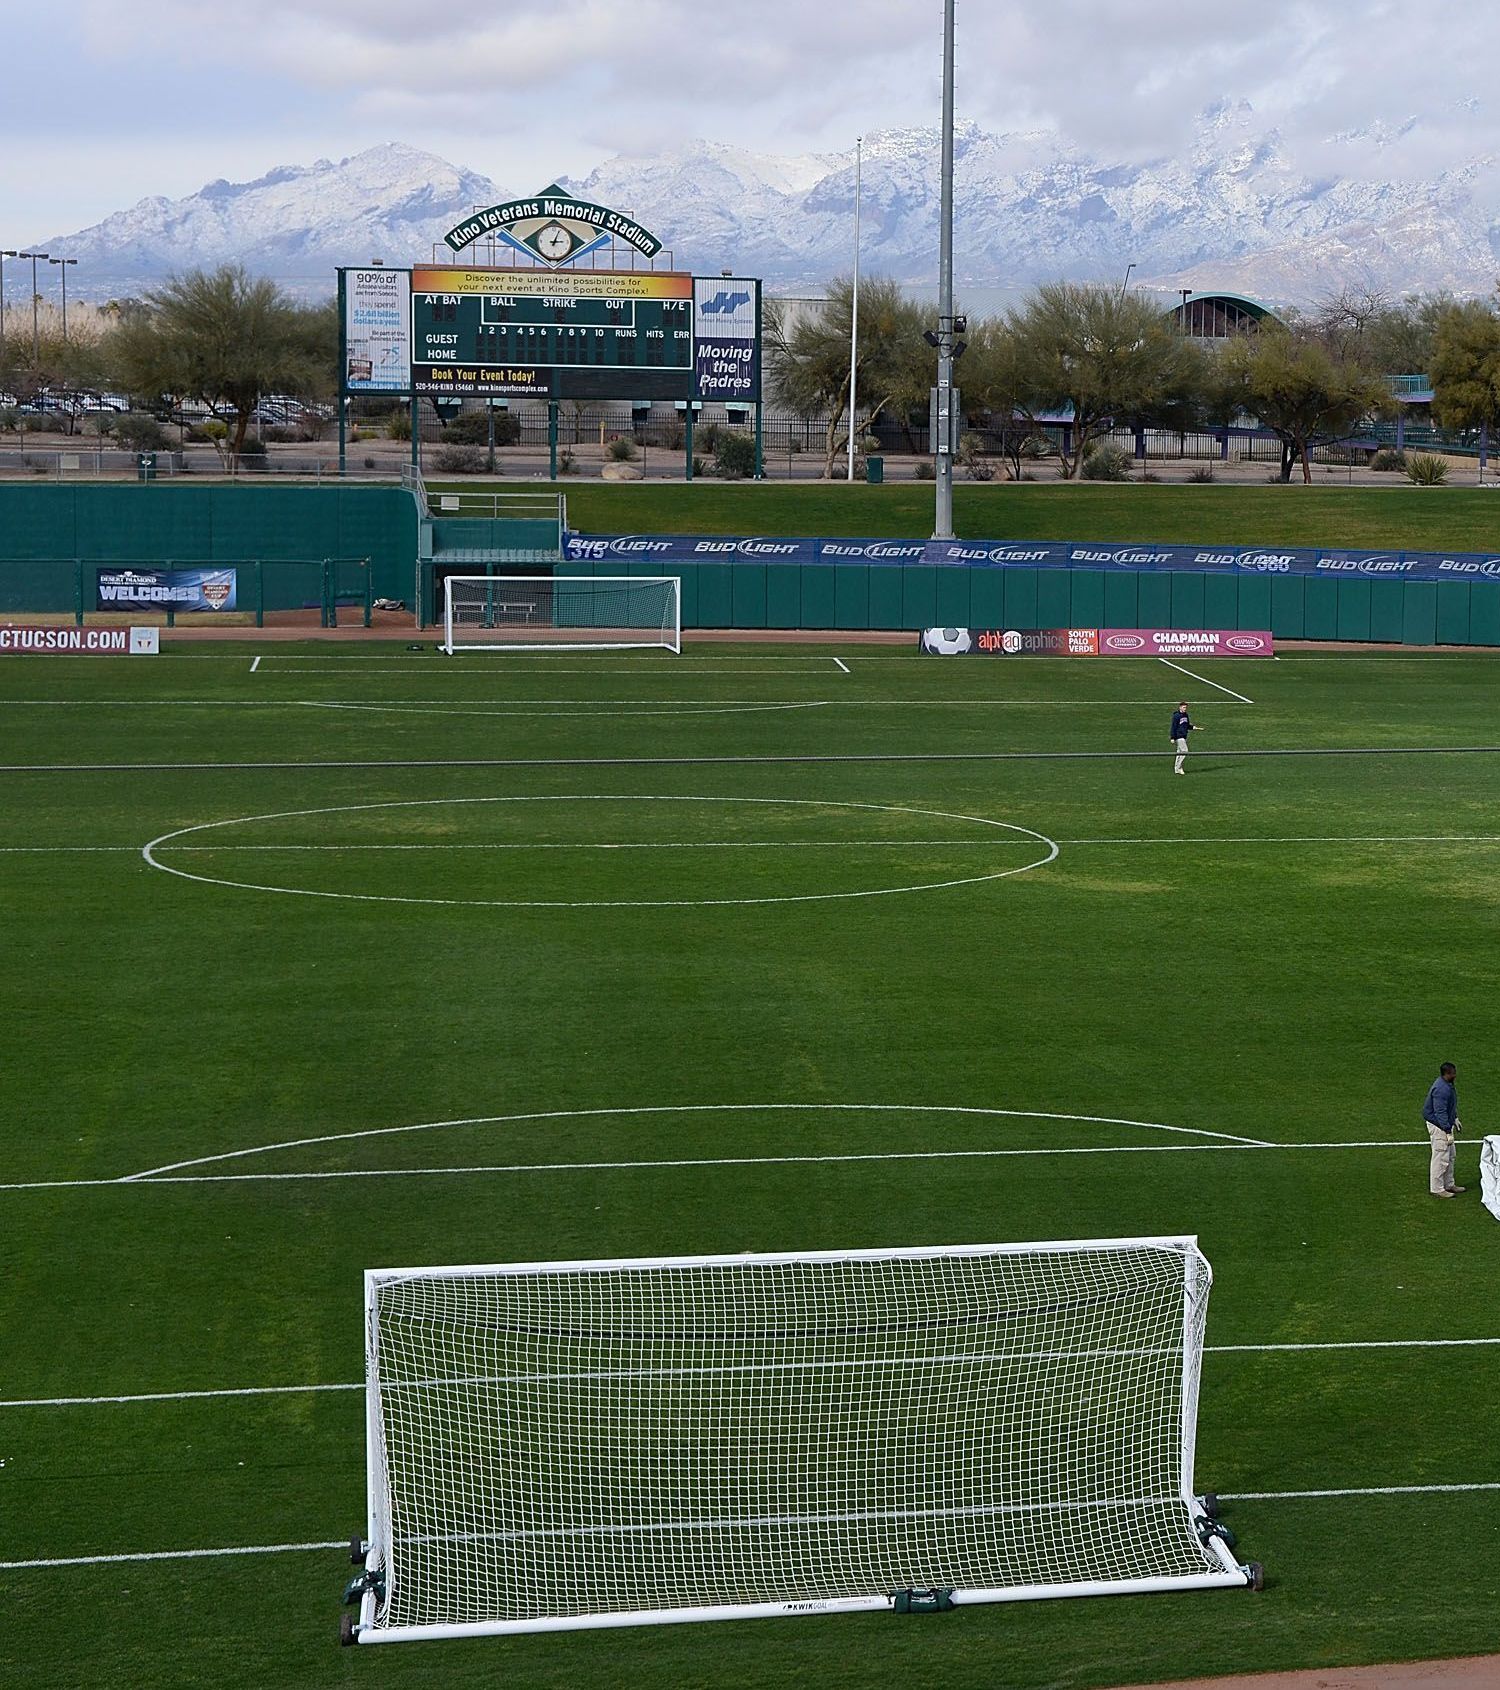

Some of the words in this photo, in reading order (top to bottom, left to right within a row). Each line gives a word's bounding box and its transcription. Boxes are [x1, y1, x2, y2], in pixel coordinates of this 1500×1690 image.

[450, 222, 480, 246] Kino
[478, 202, 538, 228] Veterans
[544, 200, 605, 224] Memorial
[606, 214, 655, 254] Stadium
[357, 274, 384, 283] 90%
[386, 274, 397, 283] of
[574, 278, 626, 286] possibilities
[425, 296, 438, 304] AT
[443, 296, 462, 305] BAT
[490, 297, 516, 306] BALL
[542, 298, 576, 308] STRIKE
[606, 300, 625, 309] OUT
[663, 302, 685, 310] H/E
[426, 334, 458, 344] GUEST
[615, 330, 638, 338] RUNS
[428, 350, 456, 359] HOME
[698, 344, 752, 362] Moving
[713, 360, 737, 373] the
[432, 368, 452, 380] Book
[457, 369, 477, 380] Your
[481, 370, 504, 381] Event
[508, 370, 536, 384] Today!
[700, 374, 752, 388] Padres
[619, 541, 672, 551] LIGHT
[694, 542, 736, 552] BUD
[747, 543, 799, 554] LIGHT
[822, 544, 864, 556] BUD
[872, 546, 925, 556] LIGHT
[947, 547, 987, 558] BUD
[996, 551, 1050, 561] LIGHT
[1071, 551, 1112, 562] BUD
[1120, 553, 1173, 563] LIGHT
[1194, 553, 1234, 564] BUD
[1317, 559, 1358, 570] BUD
[1366, 561, 1418, 571] LIGHT
[1438, 561, 1480, 572] BUD
[100, 586, 200, 600] WELCOMES
[0, 630, 126, 648] CTUCSON.COM
[978, 630, 1064, 652] alphagraphics
[1152, 633, 1220, 644] CHAPMAN
